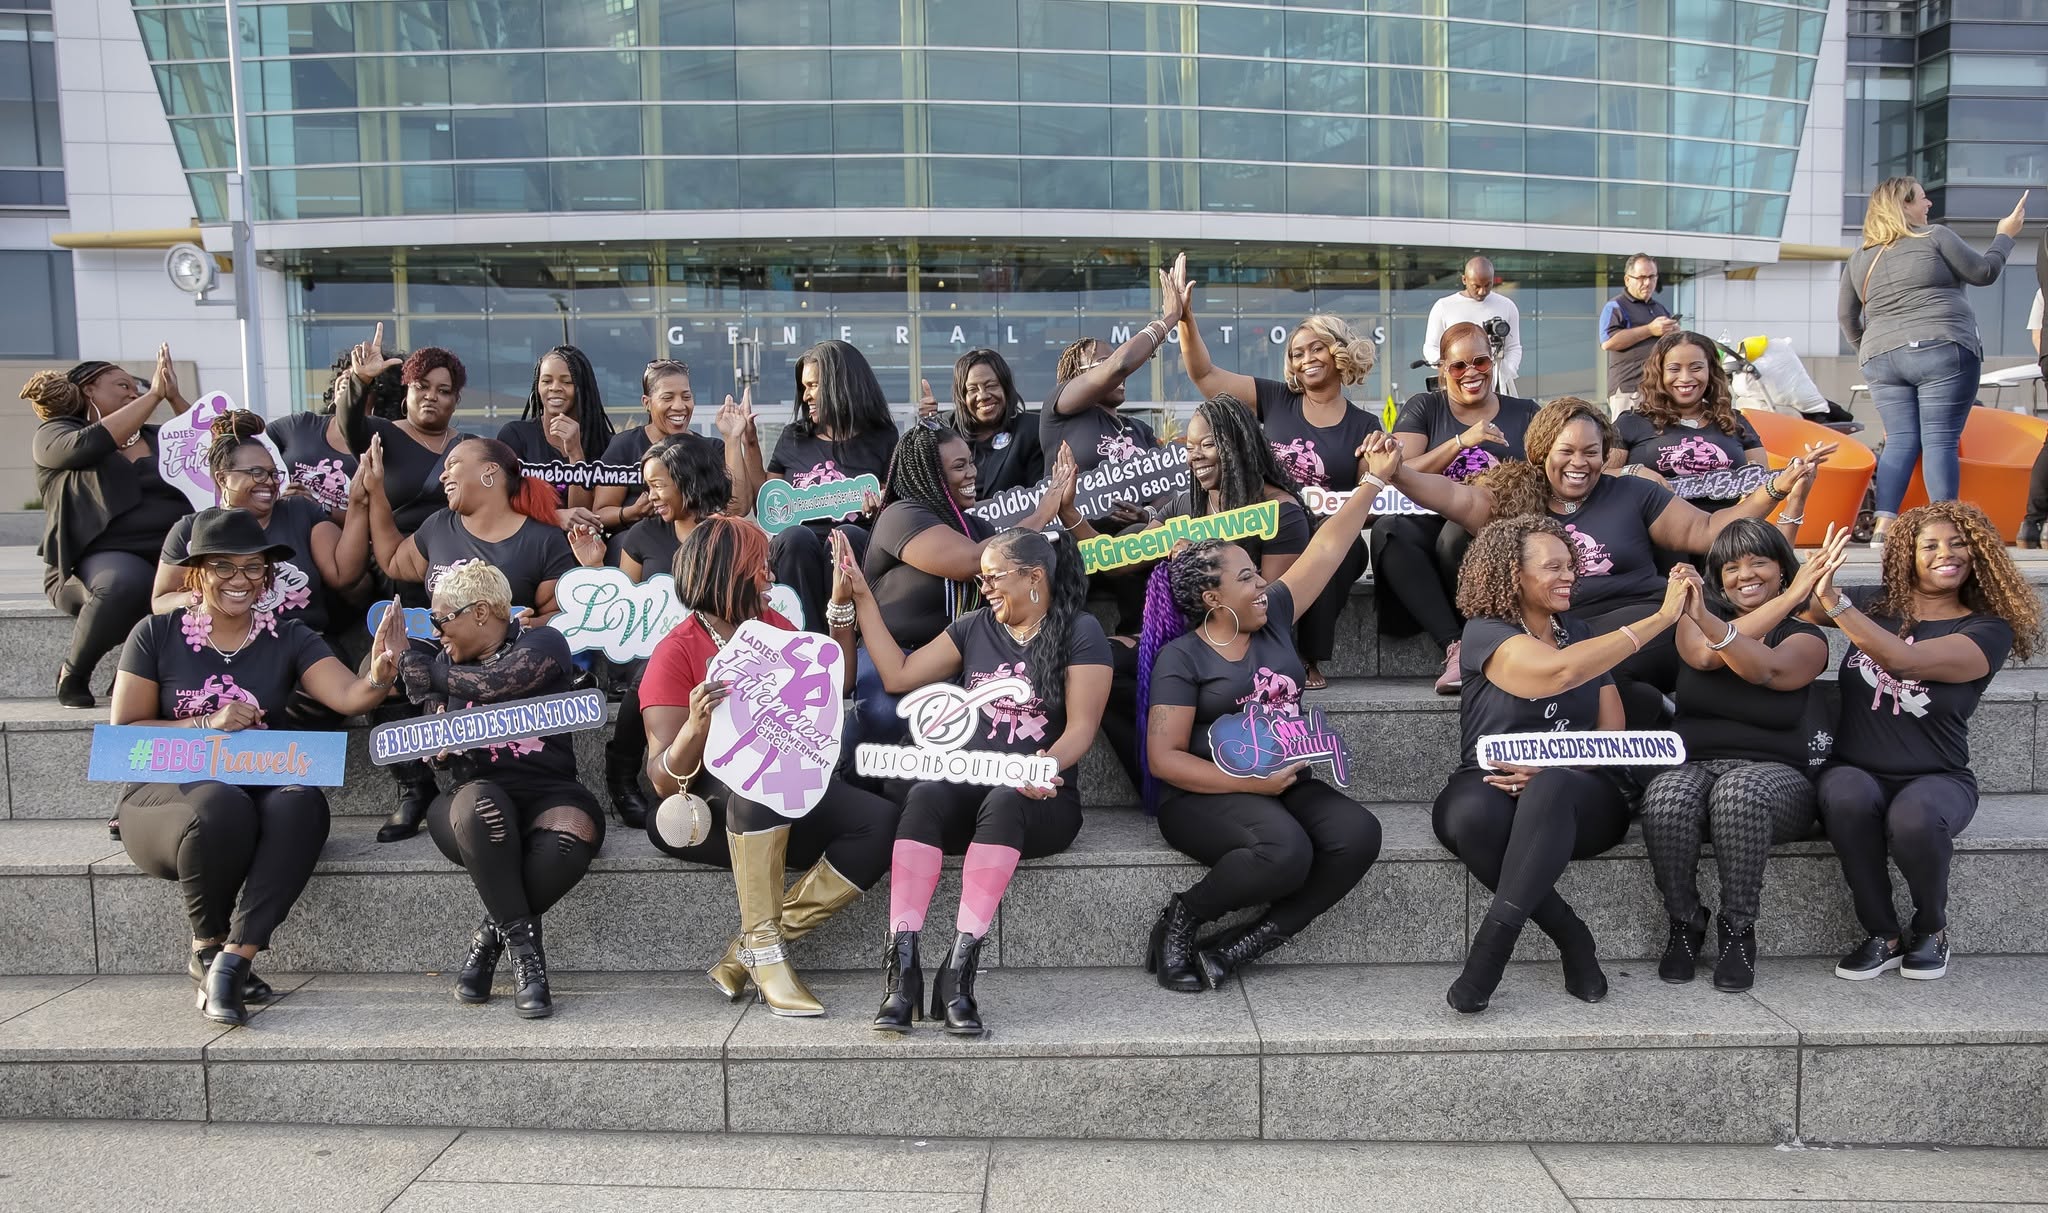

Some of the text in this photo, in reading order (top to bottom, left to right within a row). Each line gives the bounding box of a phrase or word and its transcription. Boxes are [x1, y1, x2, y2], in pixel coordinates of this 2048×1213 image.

[667, 326, 1386, 345] GENERAL MOTOS
[161, 429, 195, 441] LADIES
[521, 466, 645, 488] omebodyAmazi
[1141, 470, 1191, 498] 680-03
[739, 630, 780, 664] LADIES
[711, 649, 839, 750] Entrepreneur
[376, 694, 601, 759] #BLUEFACEDESTINATIONS
[757, 726, 792, 754] CIRCLE
[762, 717, 830, 770] EMPOWERMENT
[1485, 737, 1677, 762] #BLUEFACEDESTINATIONS
